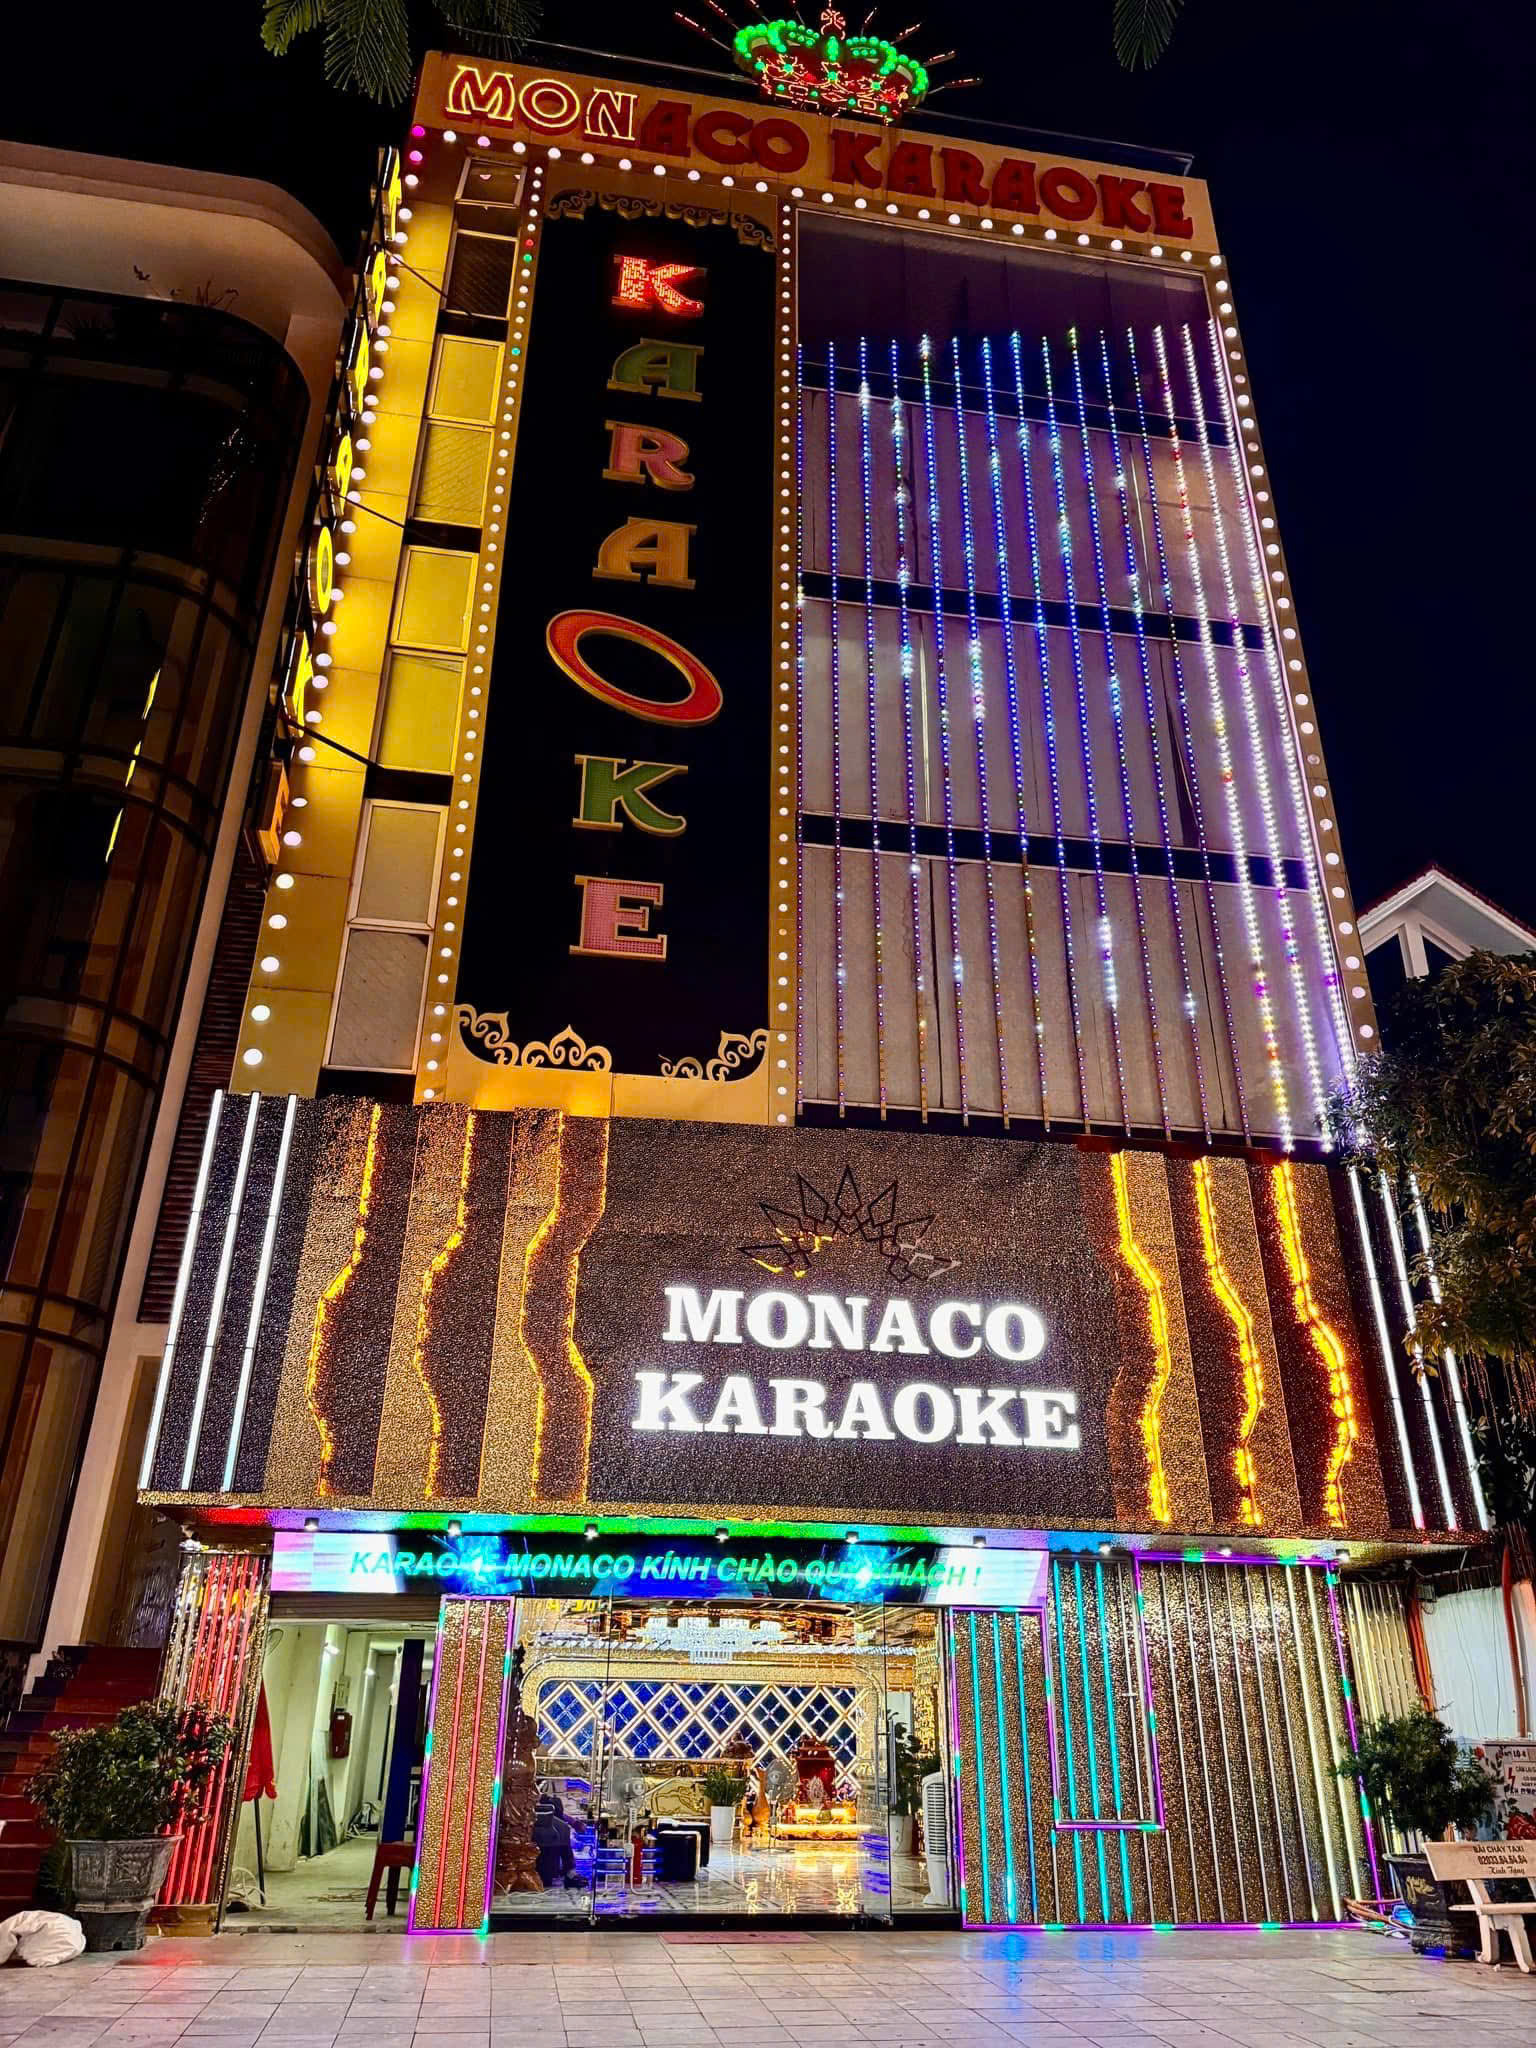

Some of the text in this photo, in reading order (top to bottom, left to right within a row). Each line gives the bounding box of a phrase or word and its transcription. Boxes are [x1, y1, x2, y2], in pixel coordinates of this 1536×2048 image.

[446, 64, 1194, 240] MONACO KARAOKE
[546, 253, 724, 963] KARAOKE
[661, 1286, 1047, 1362] MONACO
[631, 1371, 1081, 1449] KARAOKE
[351, 1551, 499, 1577] KARAOE
[504, 1553, 635, 1579] MONACO
[640, 1550, 712, 1581] KÍNH
[717, 1552, 799, 1583] CHÀO
[804, 1556, 867, 1585] QU
[1506, 1845, 1525, 1853] TAXI
